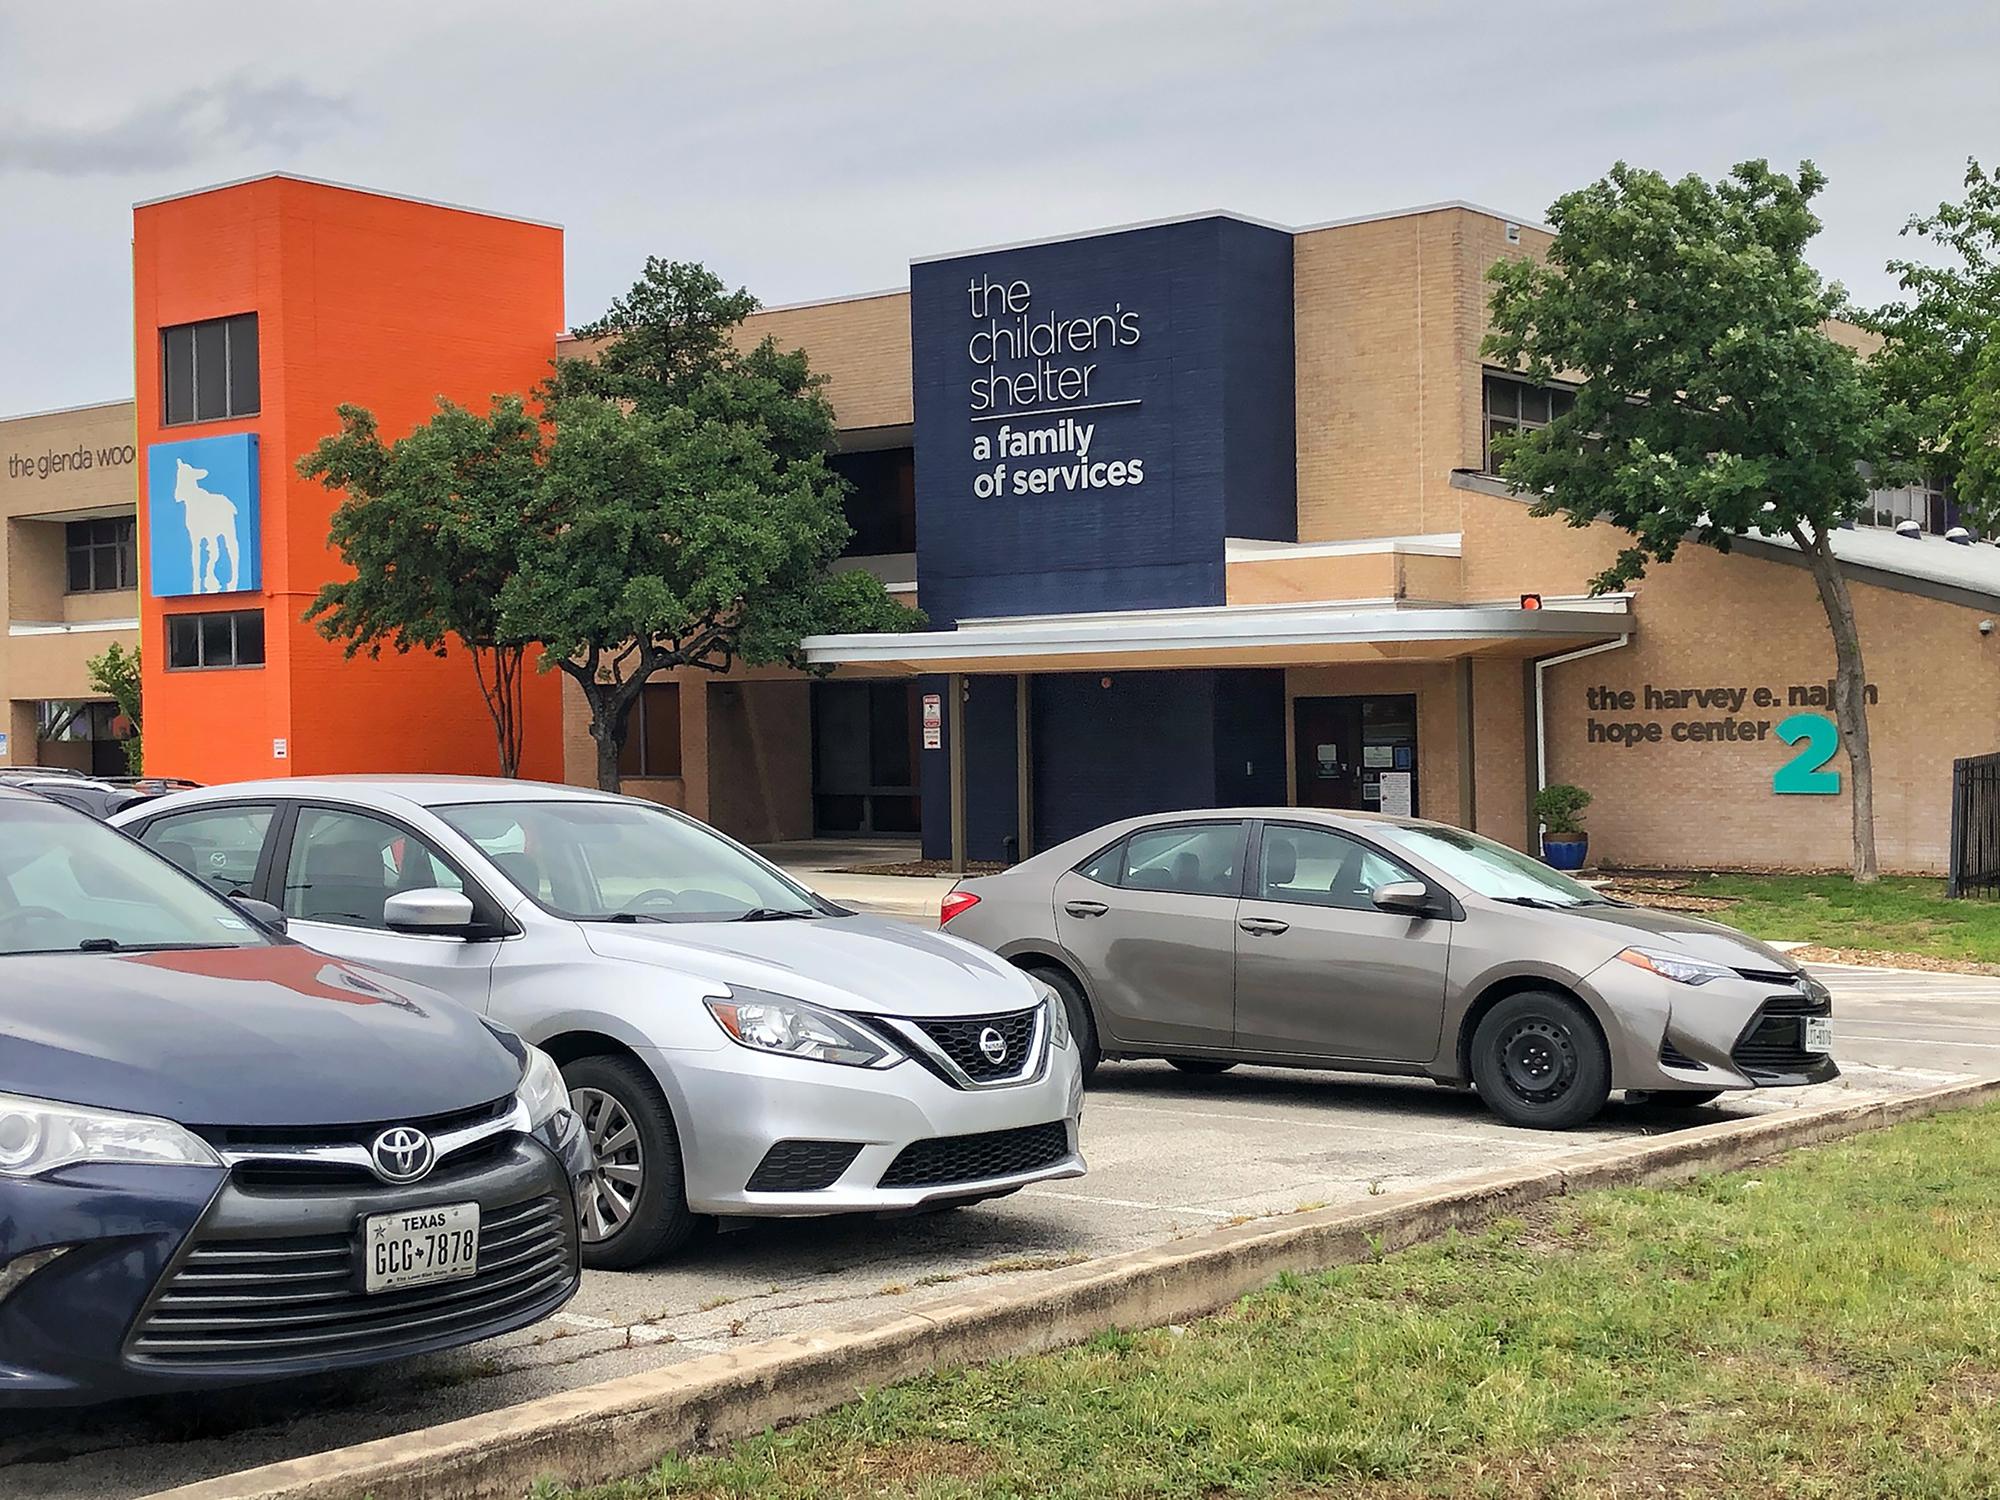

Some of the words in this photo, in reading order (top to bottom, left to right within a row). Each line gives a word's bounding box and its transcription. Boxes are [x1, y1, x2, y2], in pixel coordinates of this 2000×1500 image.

[968, 273, 1031, 319] the
[968, 302, 1141, 364] children's
[970, 358, 1097, 410] shelter
[972, 434, 991, 461] a
[998, 418, 1095, 457] family
[9, 453, 34, 478] the
[38, 444, 93, 479] glenda
[96, 444, 136, 467] woo
[973, 463, 1006, 499] of
[1012, 456, 1145, 495] services
[1586, 685, 1635, 710] the
[1644, 684, 1747, 713] harvey
[1753, 687, 1781, 707] e.
[1587, 718, 1662, 747] hope
[1671, 717, 1770, 742] center
[1773, 711, 1841, 795] 2
[402, 1213, 446, 1231] TEXAS
